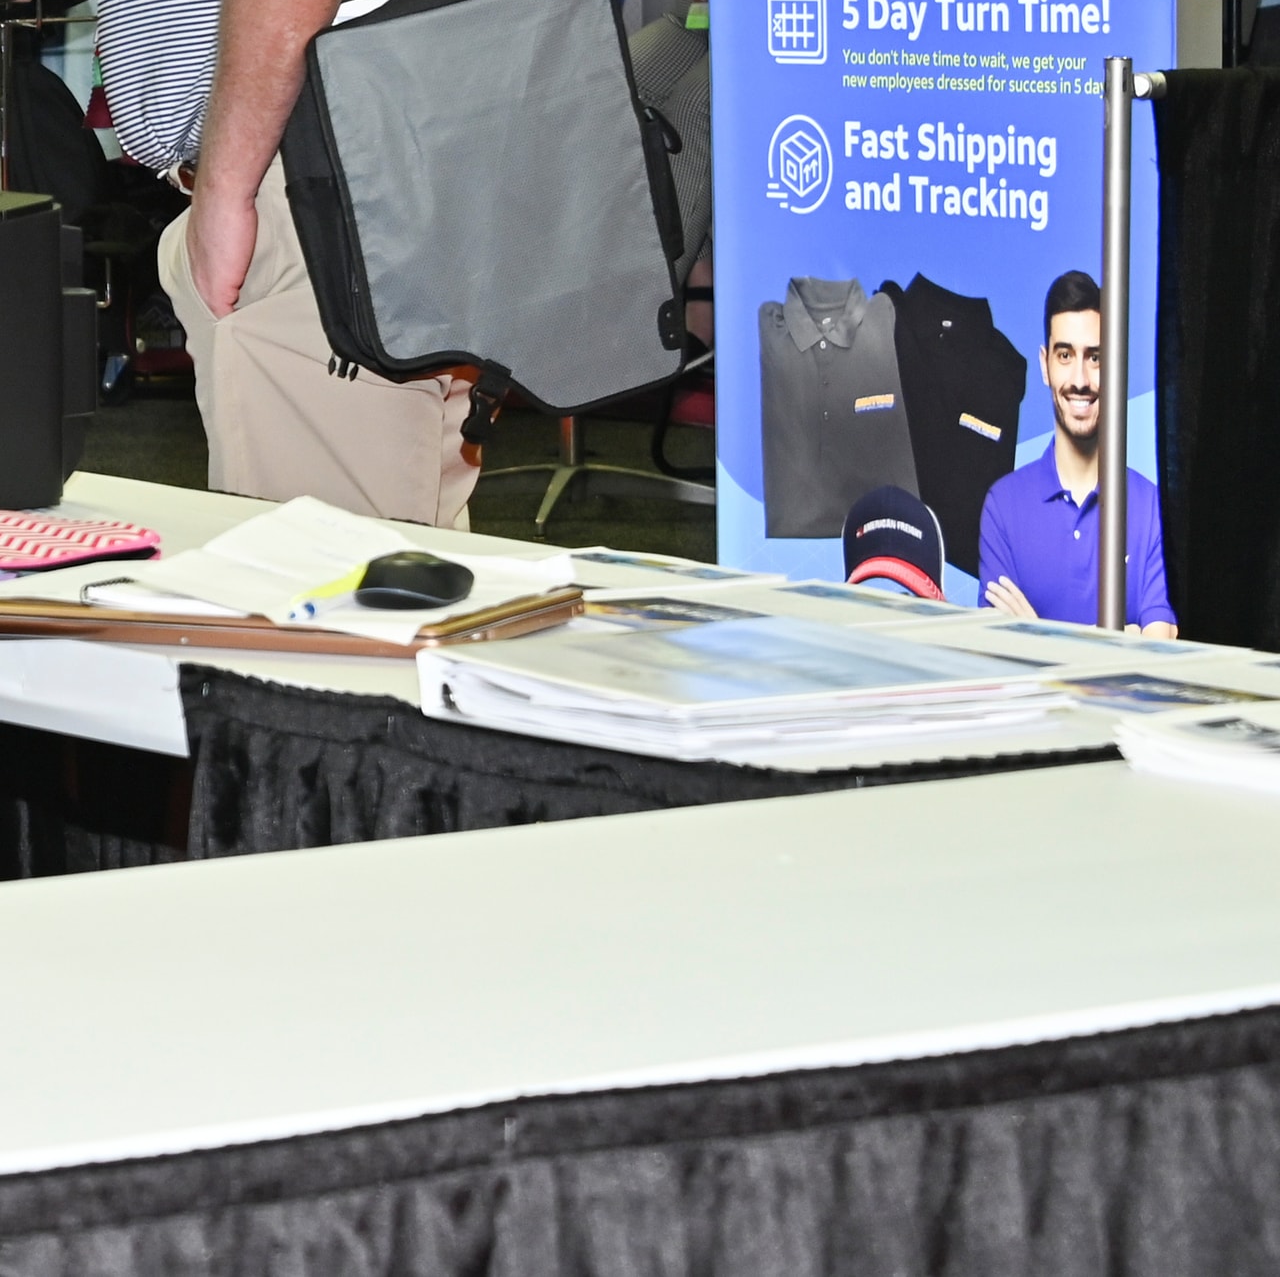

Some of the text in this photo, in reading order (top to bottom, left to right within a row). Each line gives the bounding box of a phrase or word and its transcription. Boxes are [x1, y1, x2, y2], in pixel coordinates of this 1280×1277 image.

[842, 48, 1087, 74] You don't have time wait, get your
[842, 73, 1057, 94] new employees dressed success
[844, 120, 1057, 177] Fast Shipping
[844, 172, 1049, 231] and Tracking
